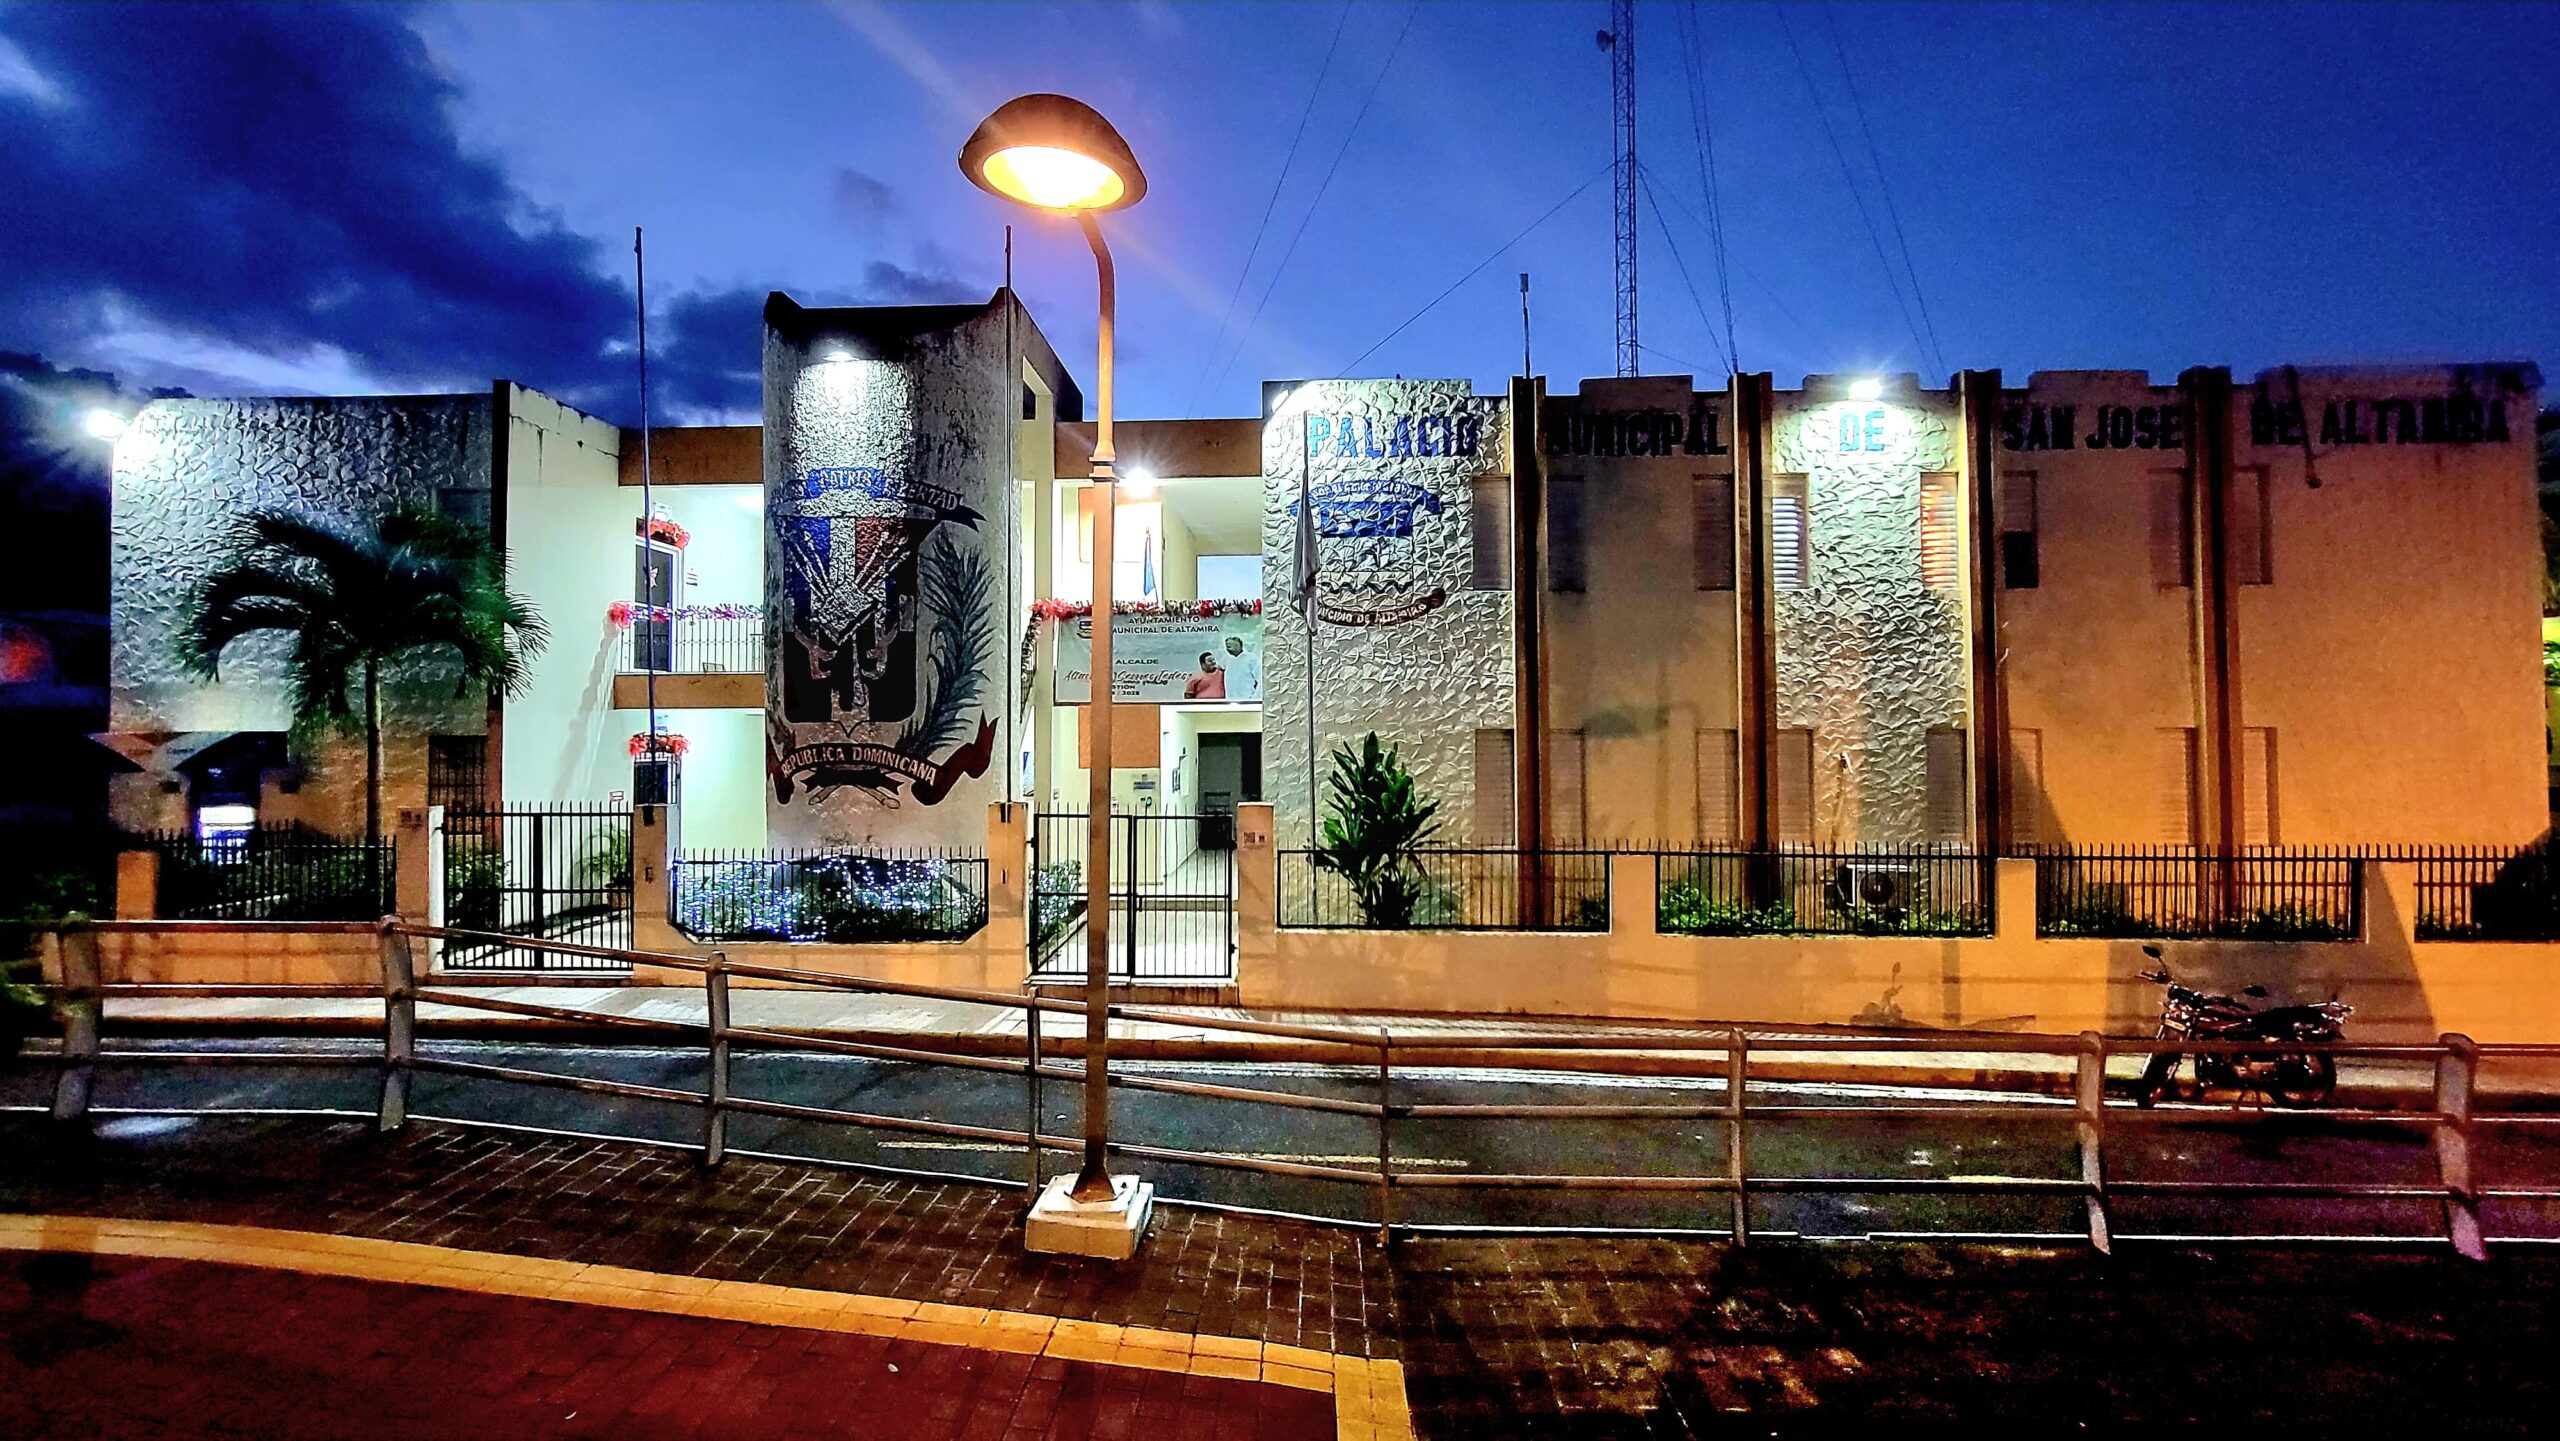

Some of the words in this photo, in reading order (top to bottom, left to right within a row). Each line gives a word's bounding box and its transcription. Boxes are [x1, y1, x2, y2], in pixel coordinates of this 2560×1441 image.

[1308, 415, 1478, 458] PALACIO
[1545, 412, 1728, 457] MUNICIPAL
[1839, 411, 1885, 451] DE
[2002, 406, 2076, 450] SAN
[2085, 404, 2183, 450] JOSE
[2252, 401, 2302, 445] DE
[2320, 399, 2510, 444] ALTAMIRA
[1128, 615, 1200, 625] AYUNTAMIENTO
[1161, 625, 1174, 633] DE
[1175, 624, 1220, 633] ALTAMIRA
[781, 746, 845, 778] REPUBLICA
[852, 746, 938, 787] DOMINICANA
